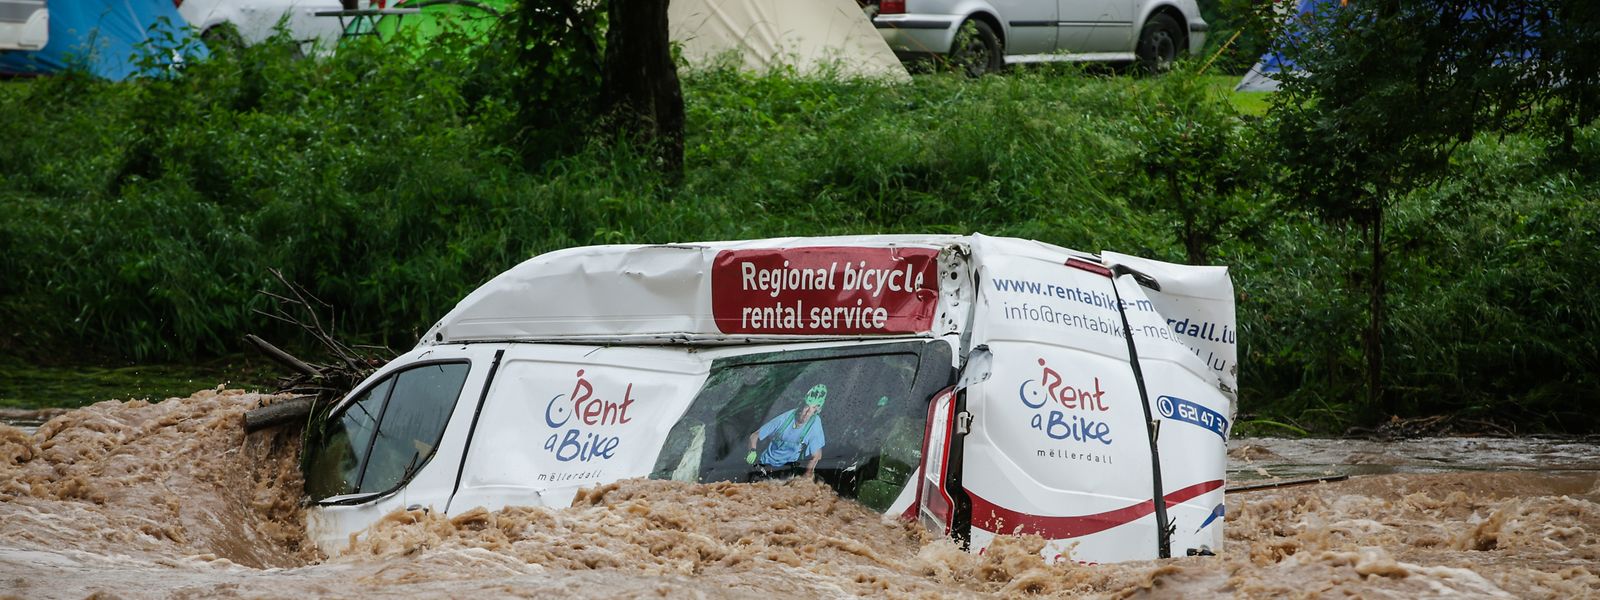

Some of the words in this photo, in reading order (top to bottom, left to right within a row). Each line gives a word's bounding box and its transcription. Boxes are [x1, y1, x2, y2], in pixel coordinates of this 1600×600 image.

[741, 260, 837, 298] Regional
[842, 260, 924, 297] bicycle
[741, 299, 804, 329] rental
[809, 298, 888, 329] service
[570, 377, 636, 426] Rent
[1042, 367, 1110, 412] Rent
[1031, 413, 1043, 431] a
[1046, 410, 1113, 445] Bike
[1178, 402, 1199, 422] 621
[1200, 410, 1215, 428] 47
[544, 433, 558, 453] a
[555, 428, 620, 462] Bike
[1037, 448, 1113, 465] mëllerdall
